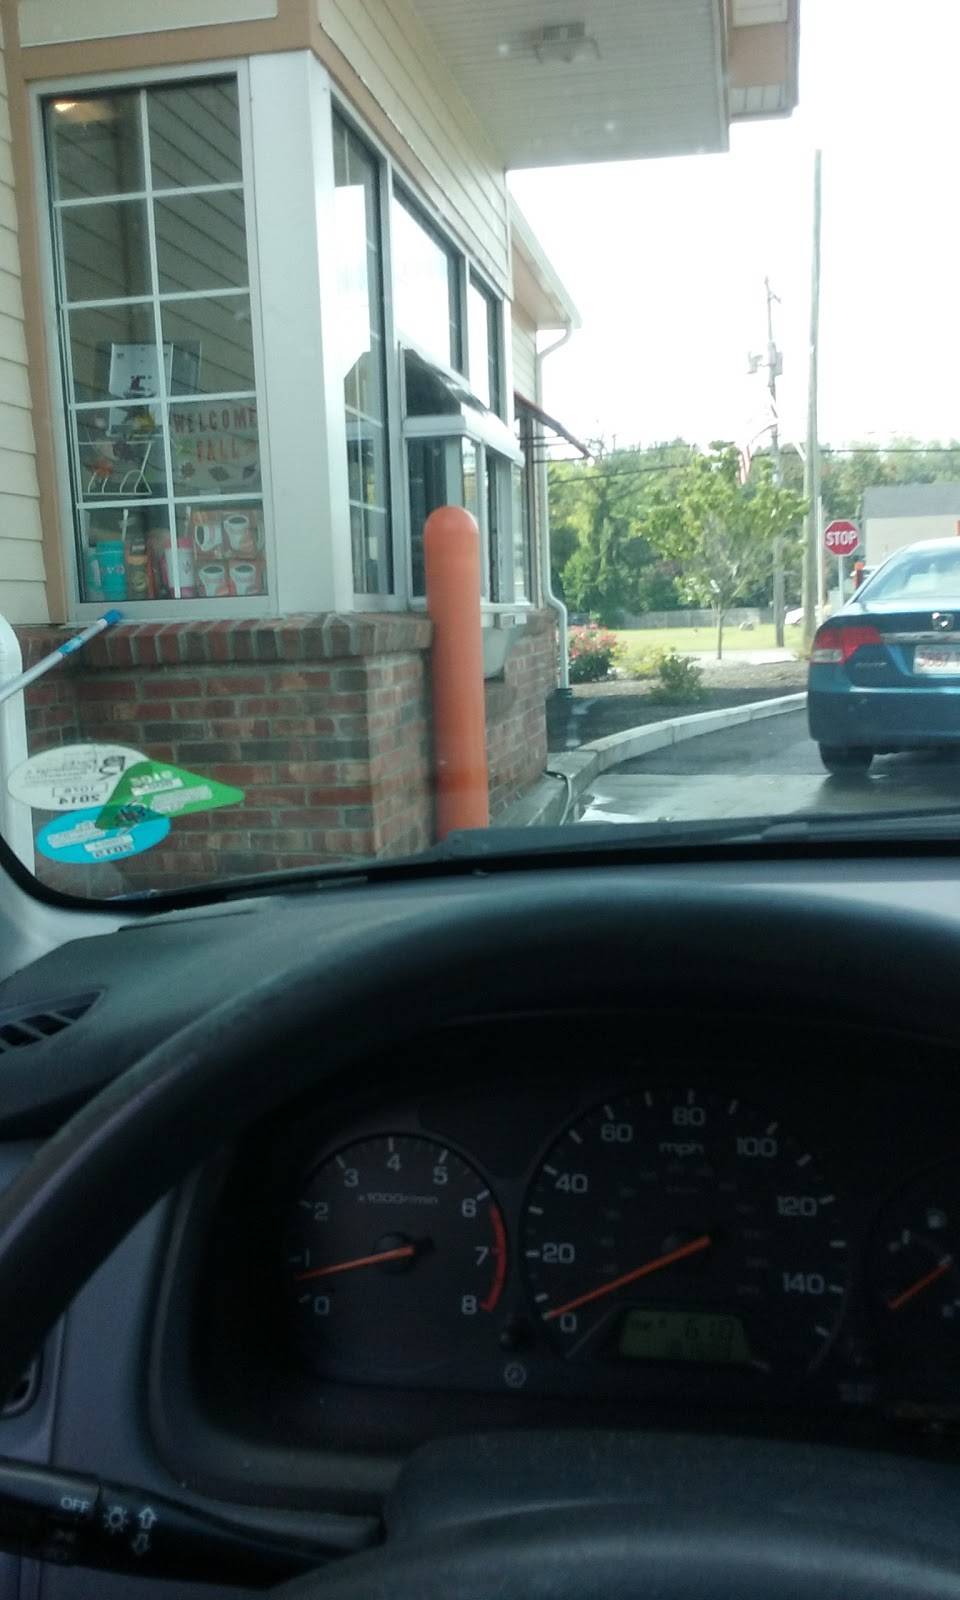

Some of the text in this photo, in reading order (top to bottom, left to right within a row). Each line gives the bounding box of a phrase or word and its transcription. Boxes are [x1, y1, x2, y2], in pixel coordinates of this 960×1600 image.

[172, 407, 257, 433] WELCOME
[825, 530, 858, 547] STOP
[672, 1106, 706, 1126] 80
[600, 1122, 633, 1143] 60
[659, 1140, 705, 1157] mph
[736, 1136, 778, 1158] 100
[386, 1153, 402, 1171] 4
[343, 1169, 359, 1187] 3
[433, 1166, 448, 1185] 5
[555, 1173, 588, 1193] 40
[313, 1202, 329, 1221] 2
[462, 1199, 476, 1217] 6
[777, 1195, 818, 1217] 120
[474, 1246, 489, 1266] 7
[541, 1242, 576, 1263] 20
[782, 1272, 825, 1294] 140
[314, 1296, 330, 1315] 0
[461, 1295, 478, 1315] 8
[559, 1311, 577, 1333] 0
[60, 1496, 91, 1513] OFF
